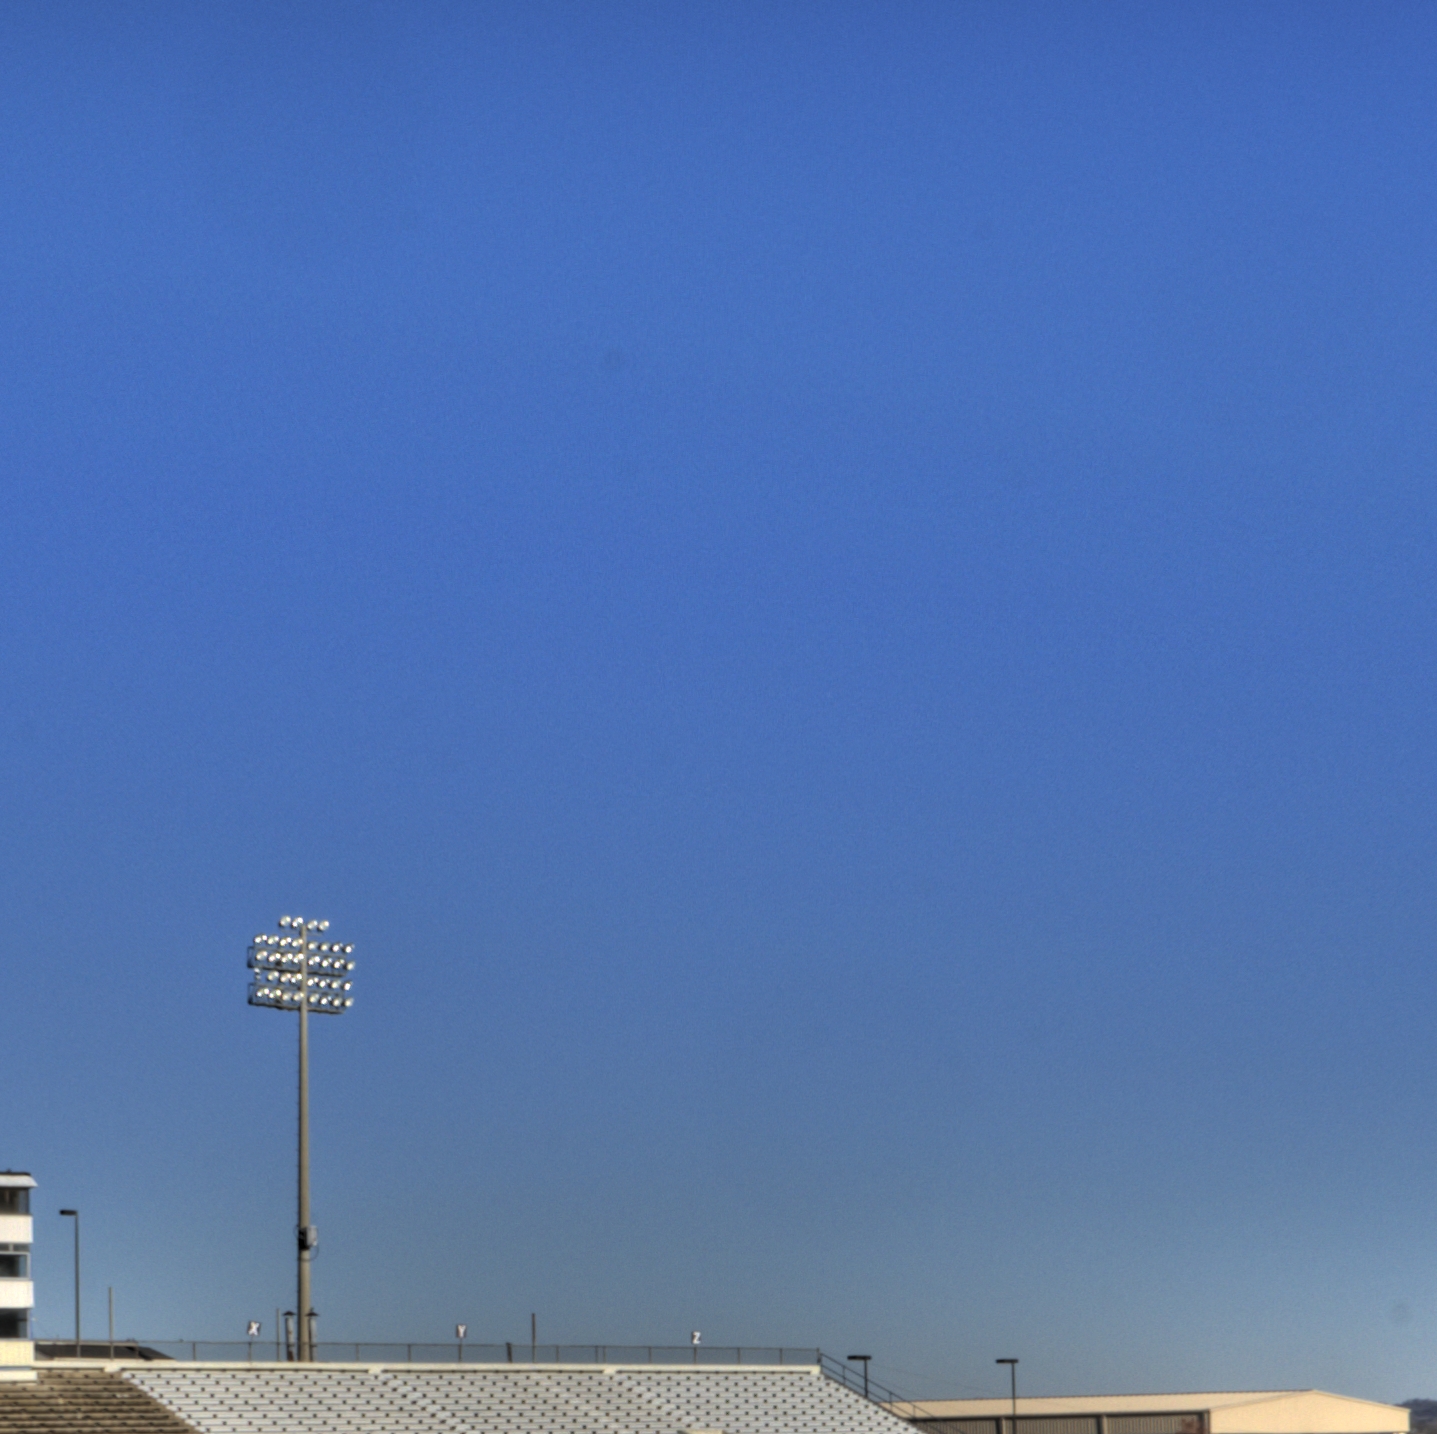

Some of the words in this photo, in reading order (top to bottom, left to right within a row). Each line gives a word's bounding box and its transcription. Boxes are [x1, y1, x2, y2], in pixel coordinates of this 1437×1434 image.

[248, 1321, 260, 1336] X
[457, 1324, 467, 1338] Y
[692, 1331, 702, 1345] Z
